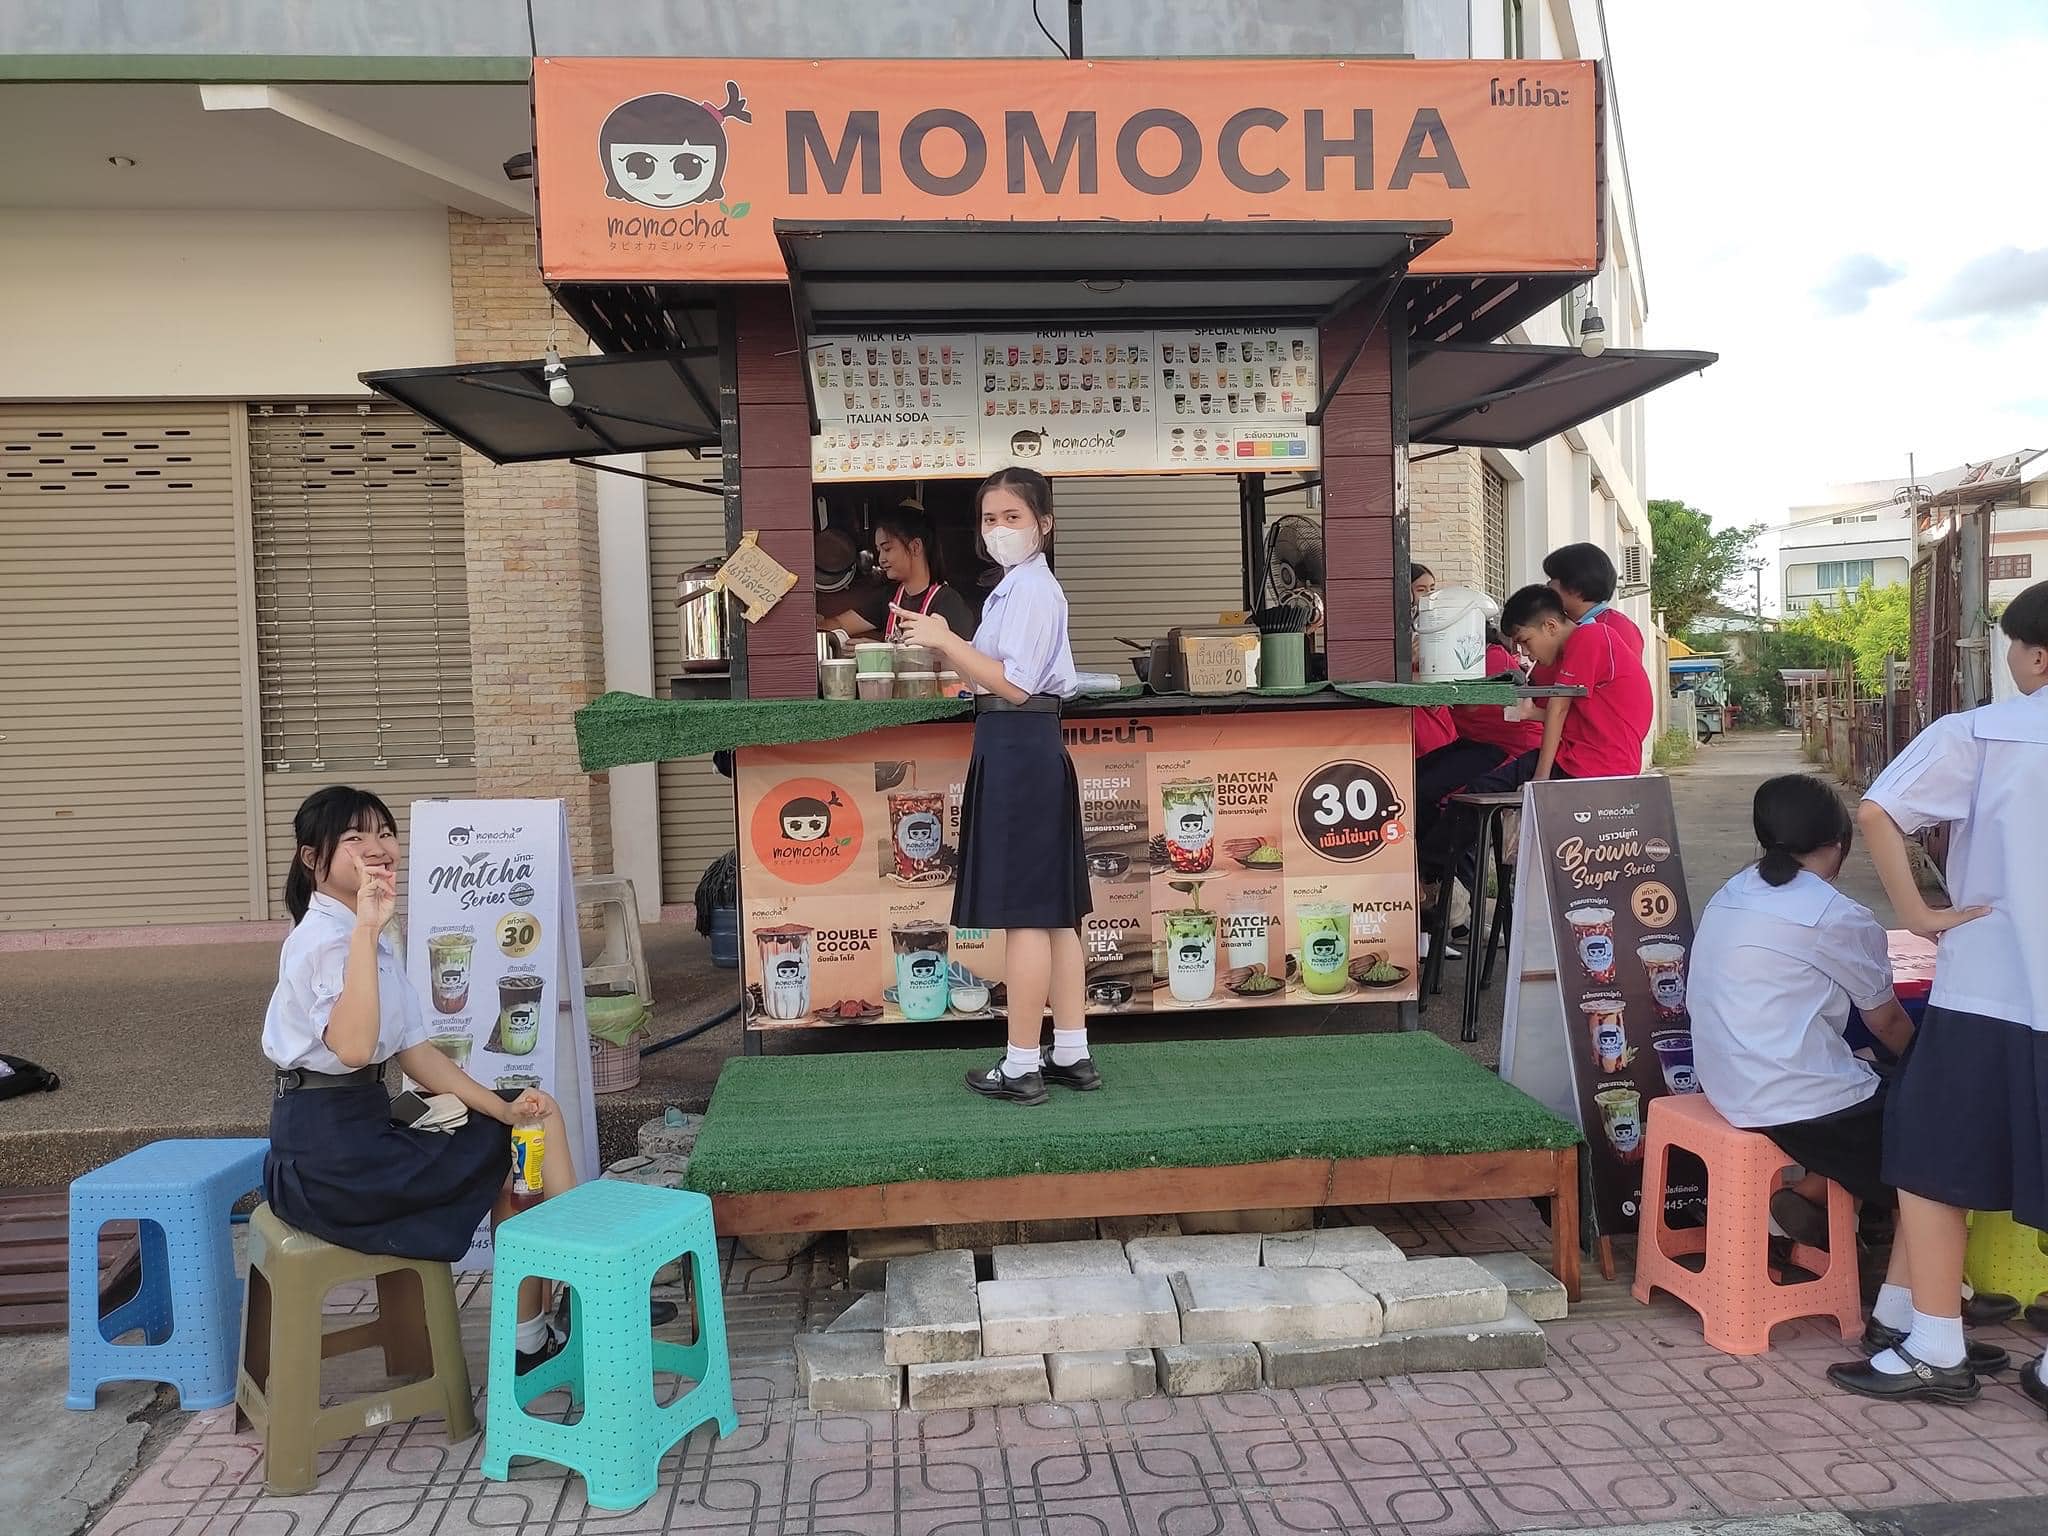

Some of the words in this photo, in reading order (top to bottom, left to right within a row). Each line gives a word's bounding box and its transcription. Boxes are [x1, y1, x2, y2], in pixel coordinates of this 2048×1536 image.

[1490, 77, 1570, 107] โมโม่ฉะ
[786, 108, 1471, 196] MOMOCHA
[607, 209, 730, 238] momocha
[846, 413, 892, 424] ITALIAN
[895, 412, 930, 423] SODA
[1052, 433, 1115, 449] momocha
[1225, 669, 1242, 685] 20
[1083, 777, 1131, 789] FRESH
[1217, 771, 1278, 783] MATCHA
[1083, 789, 1119, 801] MILK
[1217, 783, 1274, 795] BROWN
[1084, 799, 1141, 812] BROWN
[1217, 794, 1268, 806] SUGAR
[1319, 827, 1379, 849] เพิ่มไข่มุก
[773, 841, 840, 859] momocha
[1556, 836, 1644, 871] Brown
[428, 858, 535, 895] Matcha
[1572, 866, 1621, 891] Sugar
[1623, 862, 1656, 878] Series
[460, 889, 506, 911] Series
[1640, 895, 1669, 917] 30
[1352, 901, 1413, 913] MATCHA
[1087, 918, 1140, 930] COCOA
[1220, 915, 1281, 928] MATCHA
[1352, 912, 1388, 924] MILK
[501, 924, 535, 947] 30
[816, 928, 878, 941] DOUBLE
[1088, 929, 1123, 941] THAI
[1220, 927, 1266, 939] LATTE
[1353, 924, 1382, 935] TEA
[816, 940, 871, 953] COCOA
[1088, 941, 1118, 952] TEA
